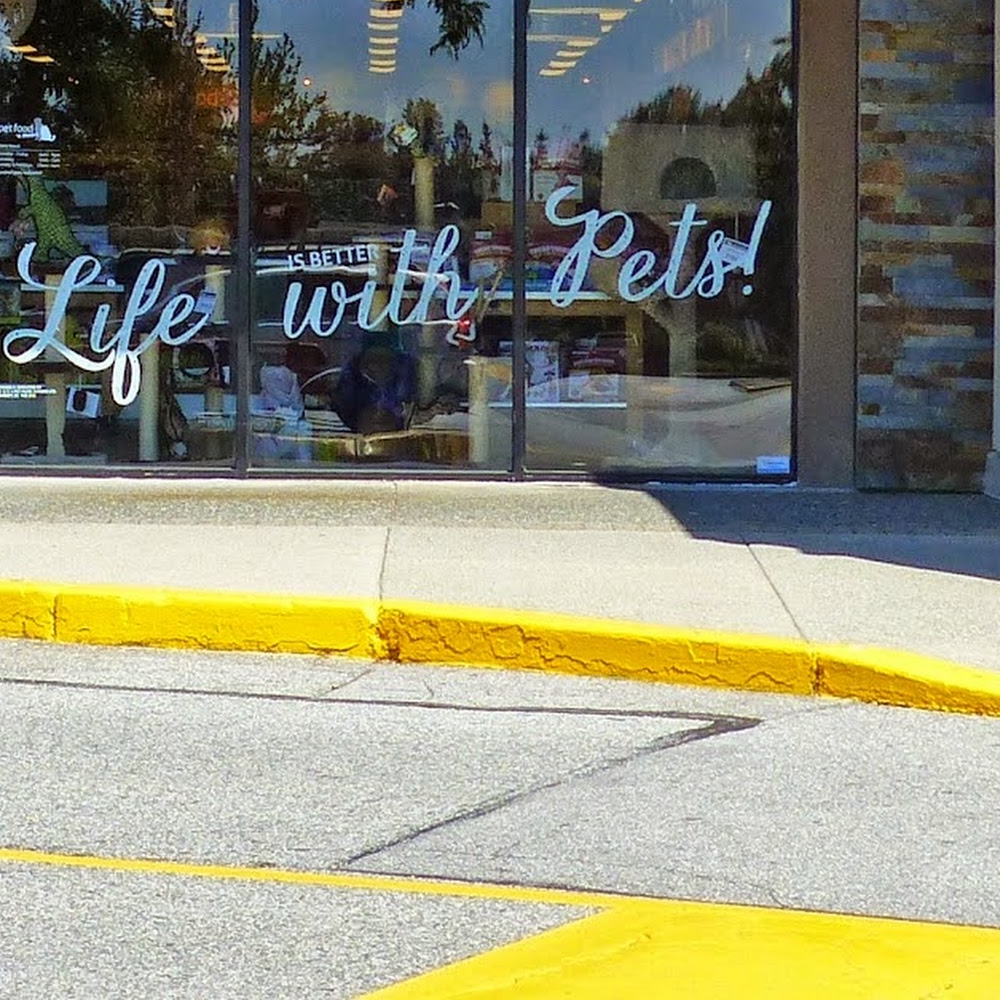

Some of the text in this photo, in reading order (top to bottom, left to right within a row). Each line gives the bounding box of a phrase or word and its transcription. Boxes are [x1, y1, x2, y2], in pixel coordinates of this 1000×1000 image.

[3, 186, 772, 406] Life with Pets!
[288, 243, 379, 270] IS BETTER
